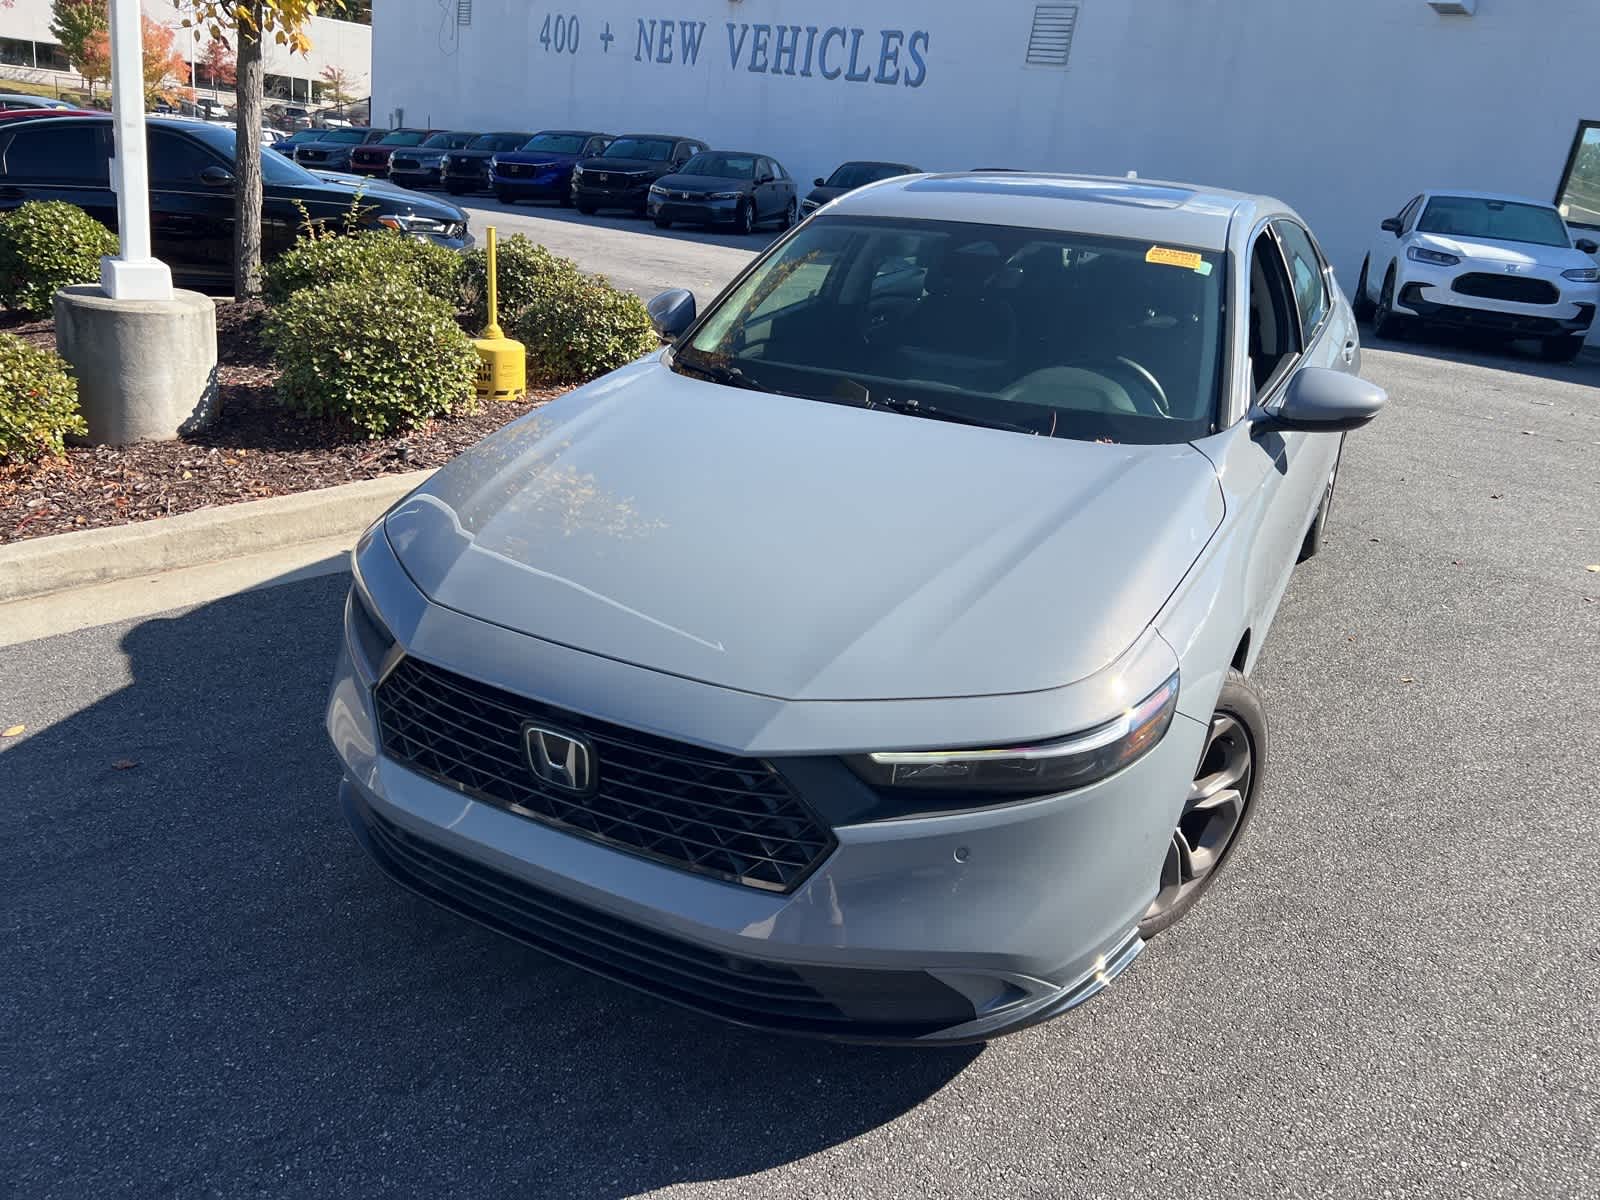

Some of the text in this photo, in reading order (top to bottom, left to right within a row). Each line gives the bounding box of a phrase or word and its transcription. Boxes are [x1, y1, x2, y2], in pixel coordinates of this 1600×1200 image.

[539, 13, 579, 54] 400
[634, 18, 707, 66] NEW
[726, 23, 930, 88] VEHICLES
